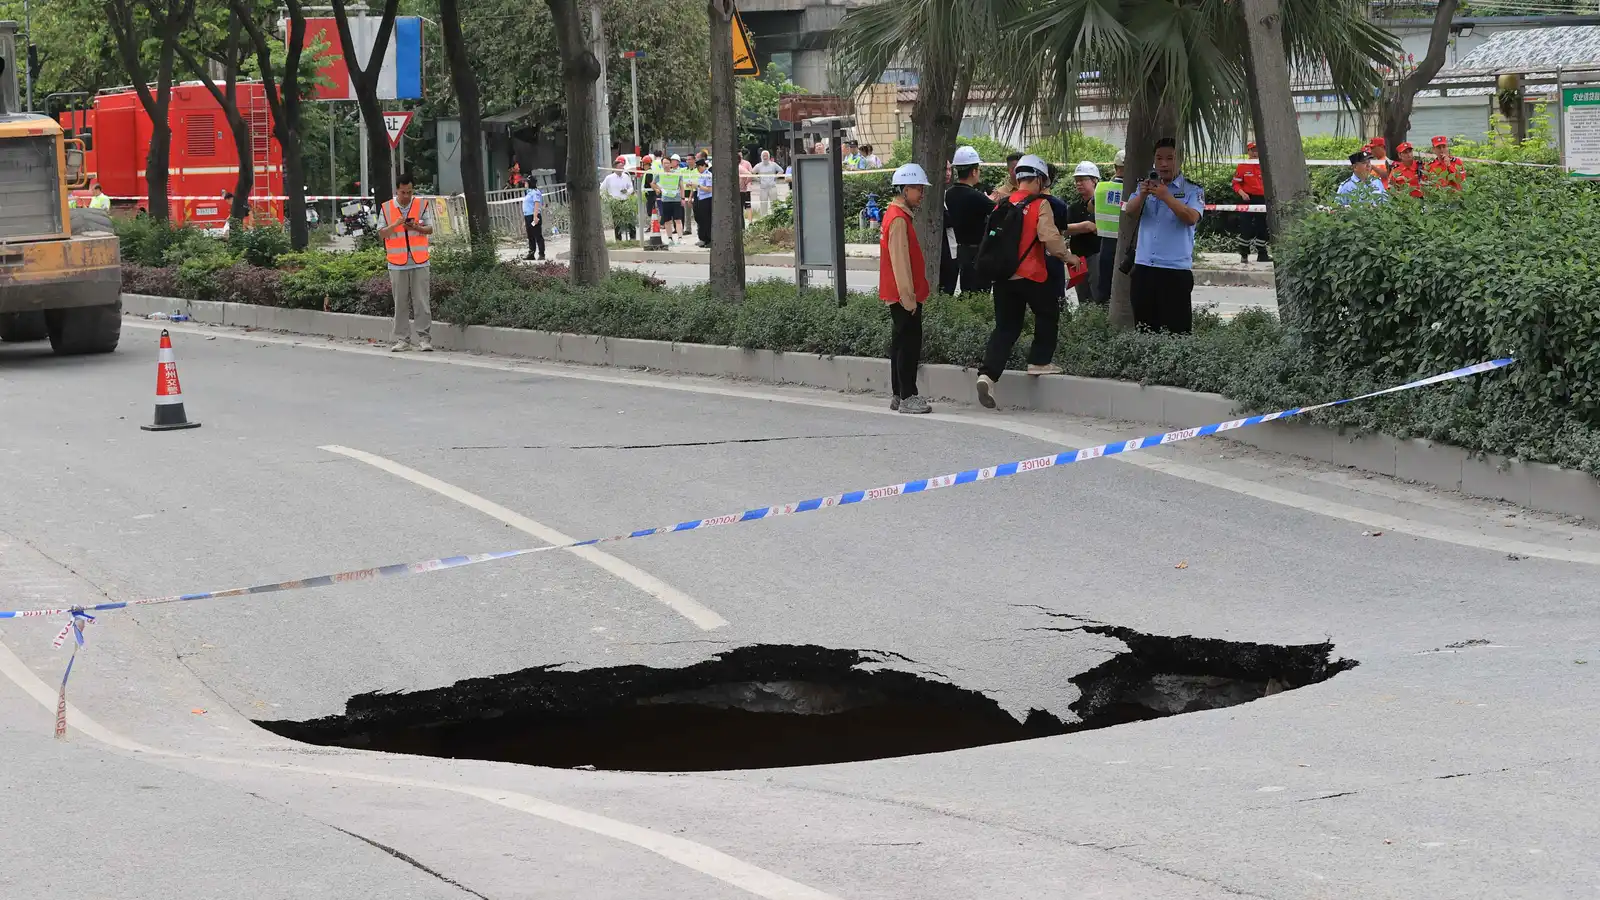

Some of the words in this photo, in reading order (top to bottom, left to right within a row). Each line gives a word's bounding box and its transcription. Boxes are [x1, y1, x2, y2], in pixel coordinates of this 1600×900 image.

[386, 117, 399, 131] 让
[1167, 429, 1195, 442] POLICE
[1022, 458, 1051, 471] POLICE
[868, 486, 899, 499] POLICE
[705, 515, 737, 526] POLICE
[335, 568, 374, 582] POLICE
